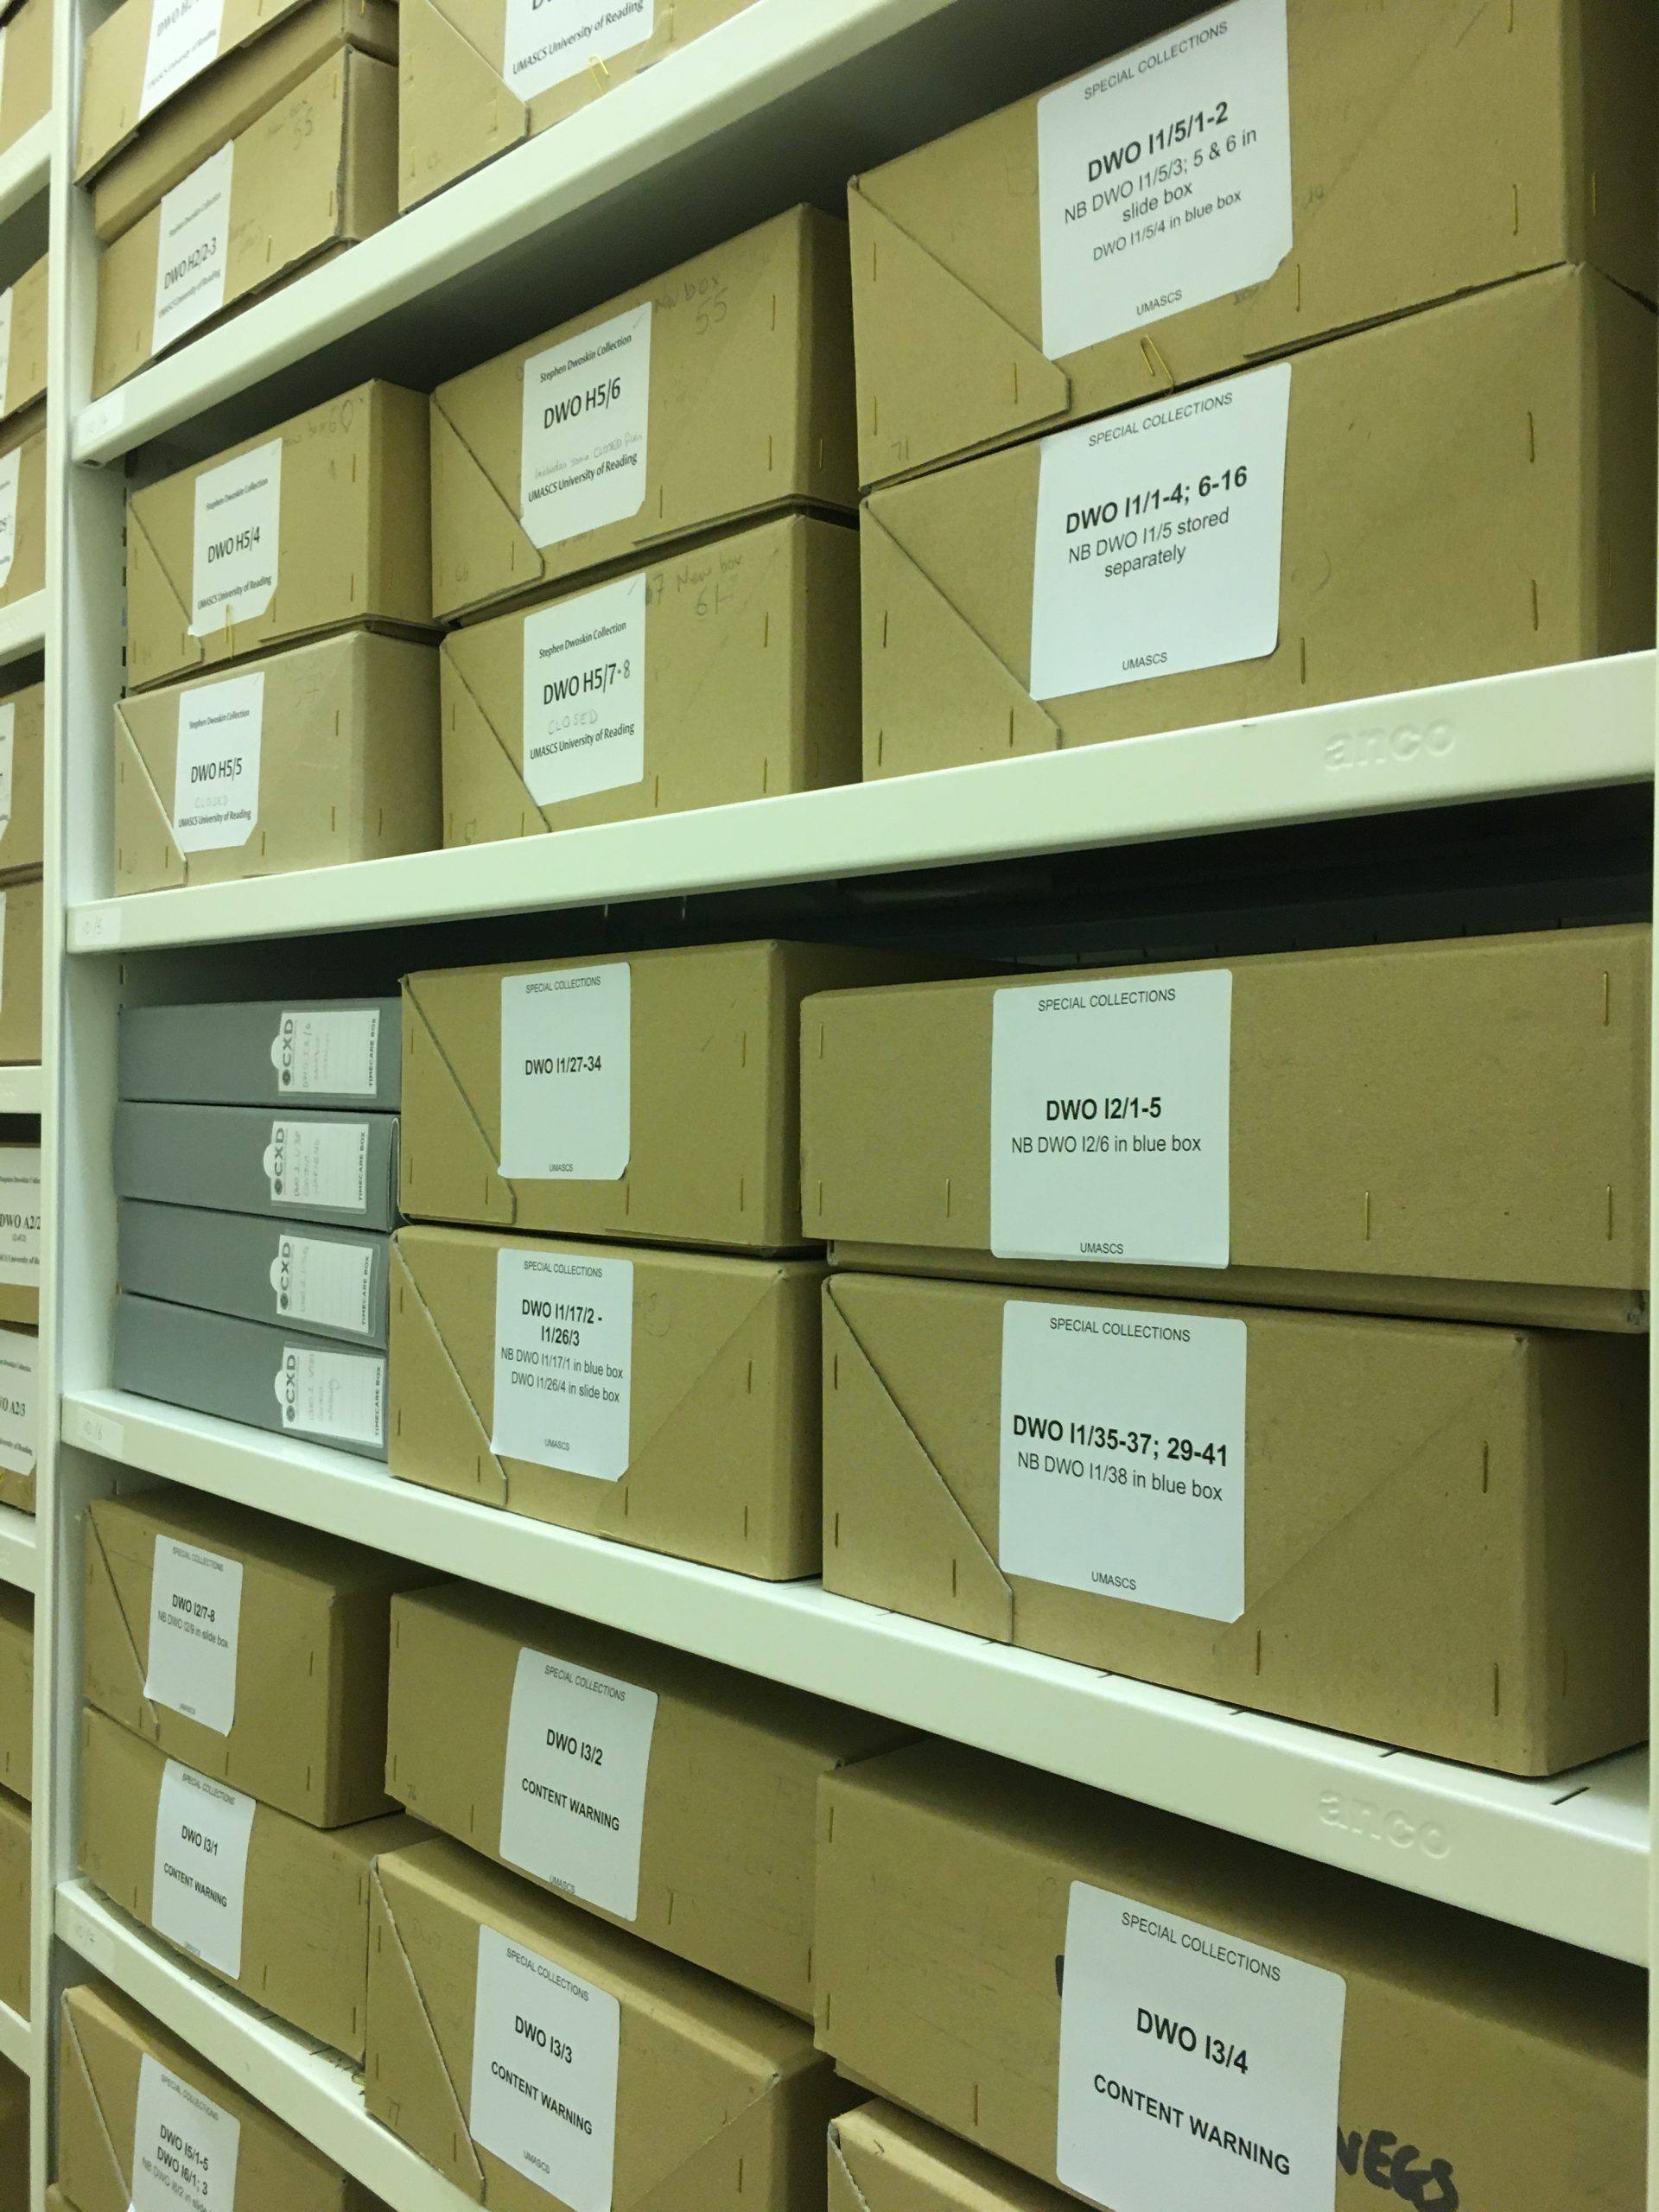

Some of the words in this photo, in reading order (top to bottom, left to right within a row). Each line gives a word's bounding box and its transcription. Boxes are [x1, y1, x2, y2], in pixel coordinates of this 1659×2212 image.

[512, 47, 547, 75] UMASCS
[549, 25, 593, 54] University
[594, 16, 604, 30] of
[605, 1, 643, 26] Reading
[1084, 69, 1135, 100] SPECIAL
[1138, 21, 1228, 73] COLLECTIONS
[1088, 141, 1141, 182] DWO
[1148, 100, 1229, 155] I1/5/1-2
[1065, 201, 1087, 224] NB
[1092, 181, 1134, 213] DWO
[1140, 158, 1188, 190] I1/5/3;
[1193, 149, 1203, 167] 5
[1209, 141, 1221, 161] &
[1226, 135, 1236, 153] 6
[1242, 128, 1257, 146] in
[1122, 195, 1159, 223] slide
[1164, 181, 1192, 206] box
[1093, 236, 1127, 261] DWO
[1130, 219, 1166, 246] I1/5/4
[1170, 214, 1181, 229] in
[1185, 202, 1213, 223] blue
[1217, 189, 1242, 210] box
[164, 260, 187, 289] DWO
[1136, 289, 1183, 316] UMASCS
[539, 365, 566, 384] Stephen
[567, 350, 596, 371] Dwoskin
[597, 334, 632, 358] Collection
[544, 394, 582, 429] DWO
[586, 377, 621, 410] H5/6
[1089, 422, 1139, 448] SPECIAL
[1142, 392, 1233, 429] COLLECTIONS
[529, 481, 557, 502] UMASCS
[558, 469, 594, 490] University
[597, 462, 605, 475] of
[606, 453, 638, 473] Reading
[1066, 502, 1117, 535] DWO
[1125, 483, 1191, 518] I1/1-4;
[1198, 465, 1248, 497] 6-16
[208, 537, 233, 563] DWO
[236, 526, 260, 551] H5/4
[1069, 543, 1090, 563] NB
[1096, 532, 1138, 557] DWO
[1142, 521, 1172, 544] I1/5
[1177, 506, 1230, 536] stored
[1104, 544, 1186, 578] separately
[539, 643, 563, 658] Stephen
[565, 632, 592, 649] Dwoskin
[594, 621, 626, 639] Collection
[1122, 652, 1167, 671] UMASCS
[543, 676, 579, 705] DWO
[549, 709, 597, 734] CLOSED
[530, 741, 558, 760] UMASCS
[559, 734, 594, 752] University
[594, 728, 604, 741] of
[604, 722, 634, 740] Reading
[191, 762, 216, 783] DWO
[219, 758, 242, 781] H5/5
[179, 817, 198, 828] UMASCS
[199, 813, 222, 824] University
[223, 810, 229, 820] of
[230, 809, 251, 820] Reading
[525, 982, 552, 994] SPECIAL
[554, 976, 601, 990] COLLECTIONS
[1038, 996, 1086, 1012] SPECIAL
[1090, 988, 1175, 1007] COLLECTIONS
[525, 1058, 553, 1075] DWO
[556, 1055, 601, 1074] I1/27-34
[1046, 1099, 1096, 1121] DWO
[1105, 1096, 1161, 1119] I2/1-5
[1012, 1137, 1033, 1154] NB
[1038, 1136, 1077, 1153] DWO
[1082, 1135, 1109, 1152] I2/6
[1115, 1135, 1128, 1152] in
[1133, 1135, 1166, 1152] blue
[1172, 1135, 1201, 1152] box
[0, 1213, 21, 1228] DWO
[1080, 1243, 1123, 1255] UMASCS
[524, 1261, 552, 1273] SPECIAL
[553, 1263, 602, 1278] COLLECTIONS
[522, 1299, 551, 1318] DWO
[556, 1304, 594, 1324] I1/17/2
[541, 1325, 580, 1346] I1/26/3
[1050, 1318, 1098, 1333] SPECIAL
[1103, 1322, 1191, 1342] COLLECTIONS
[501, 1347, 514, 1361] NB
[516, 1349, 539, 1365] DWO
[542, 1354, 570, 1370] I1/17/1
[574, 1358, 582, 1371] in
[584, 1360, 603, 1376] blue
[607, 1364, 624, 1379] box
[512, 1371, 534, 1387] DWO
[537, 1376, 566, 1393] I1/26/4
[569, 1381, 576, 1395] in
[579, 1383, 600, 1399] slide
[603, 1387, 620, 1402] box
[544, 1438, 569, 1452] UMASCS
[1014, 1414, 1063, 1441] DWO
[1071, 1423, 1159, 1459] I1/35-37;
[1166, 1438, 1228, 1467] 29-41
[1018, 1452, 1039, 1470] NB
[1045, 1456, 1084, 1478] DWO
[1090, 1461, 1128, 1485] I1/38
[1133, 1470, 1146, 1488] in
[1152, 1471, 1186, 1495] blue
[1192, 1478, 1223, 1501] box
[1091, 1571, 1137, 1590] UMASCS
[173, 1594, 192, 1613] DWO
[194, 1602, 215, 1622] I2/7-8
[544, 1665, 573, 1683] SPECIAL
[575, 1675, 626, 1701] COLLECTIONS
[546, 1728, 577, 1755] DWO
[581, 1741, 603, 1766] I3/2
[182, 1772, 200, 1790] SPECIAL
[202, 1783, 235, 1806] COLLECTIONS
[522, 1777, 567, 1808] CONTENT
[569, 1797, 620, 1831] WARNING
[181, 1825, 201, 1847] DWO
[203, 1836, 218, 1856] I3/1
[164, 1862, 193, 1887] CONTENT
[195, 1881, 227, 1908] WARNING
[550, 1874, 575, 1894] UMASCS
[1122, 1912, 1178, 1944] SPECIAL
[1181, 1934, 1281, 1981] COLLECTIONS
[506, 1948, 536, 1972] SPECIAL
[537, 1965, 589, 2001] COLLECTIONS
[515, 2015, 546, 2047] DWO
[550, 2036, 573, 2063] I3/3
[1136, 2007, 1197, 2052] DWO
[1205, 2035, 1249, 2075] I3/4
[491, 2062, 539, 2101] CONTENT
[541, 2091, 593, 2135] WARNING
[1094, 2074, 1183, 2129] CONTENT
[1190, 2115, 1290, 2176] WARNING
[161, 2124, 182, 2151] DWO
[185, 2143, 209, 2171] I5/1-5
[524, 2150, 550, 2174] UMASCS
[157, 2146, 180, 2172] DWO
[202, 2182, 207, 2195] 3
